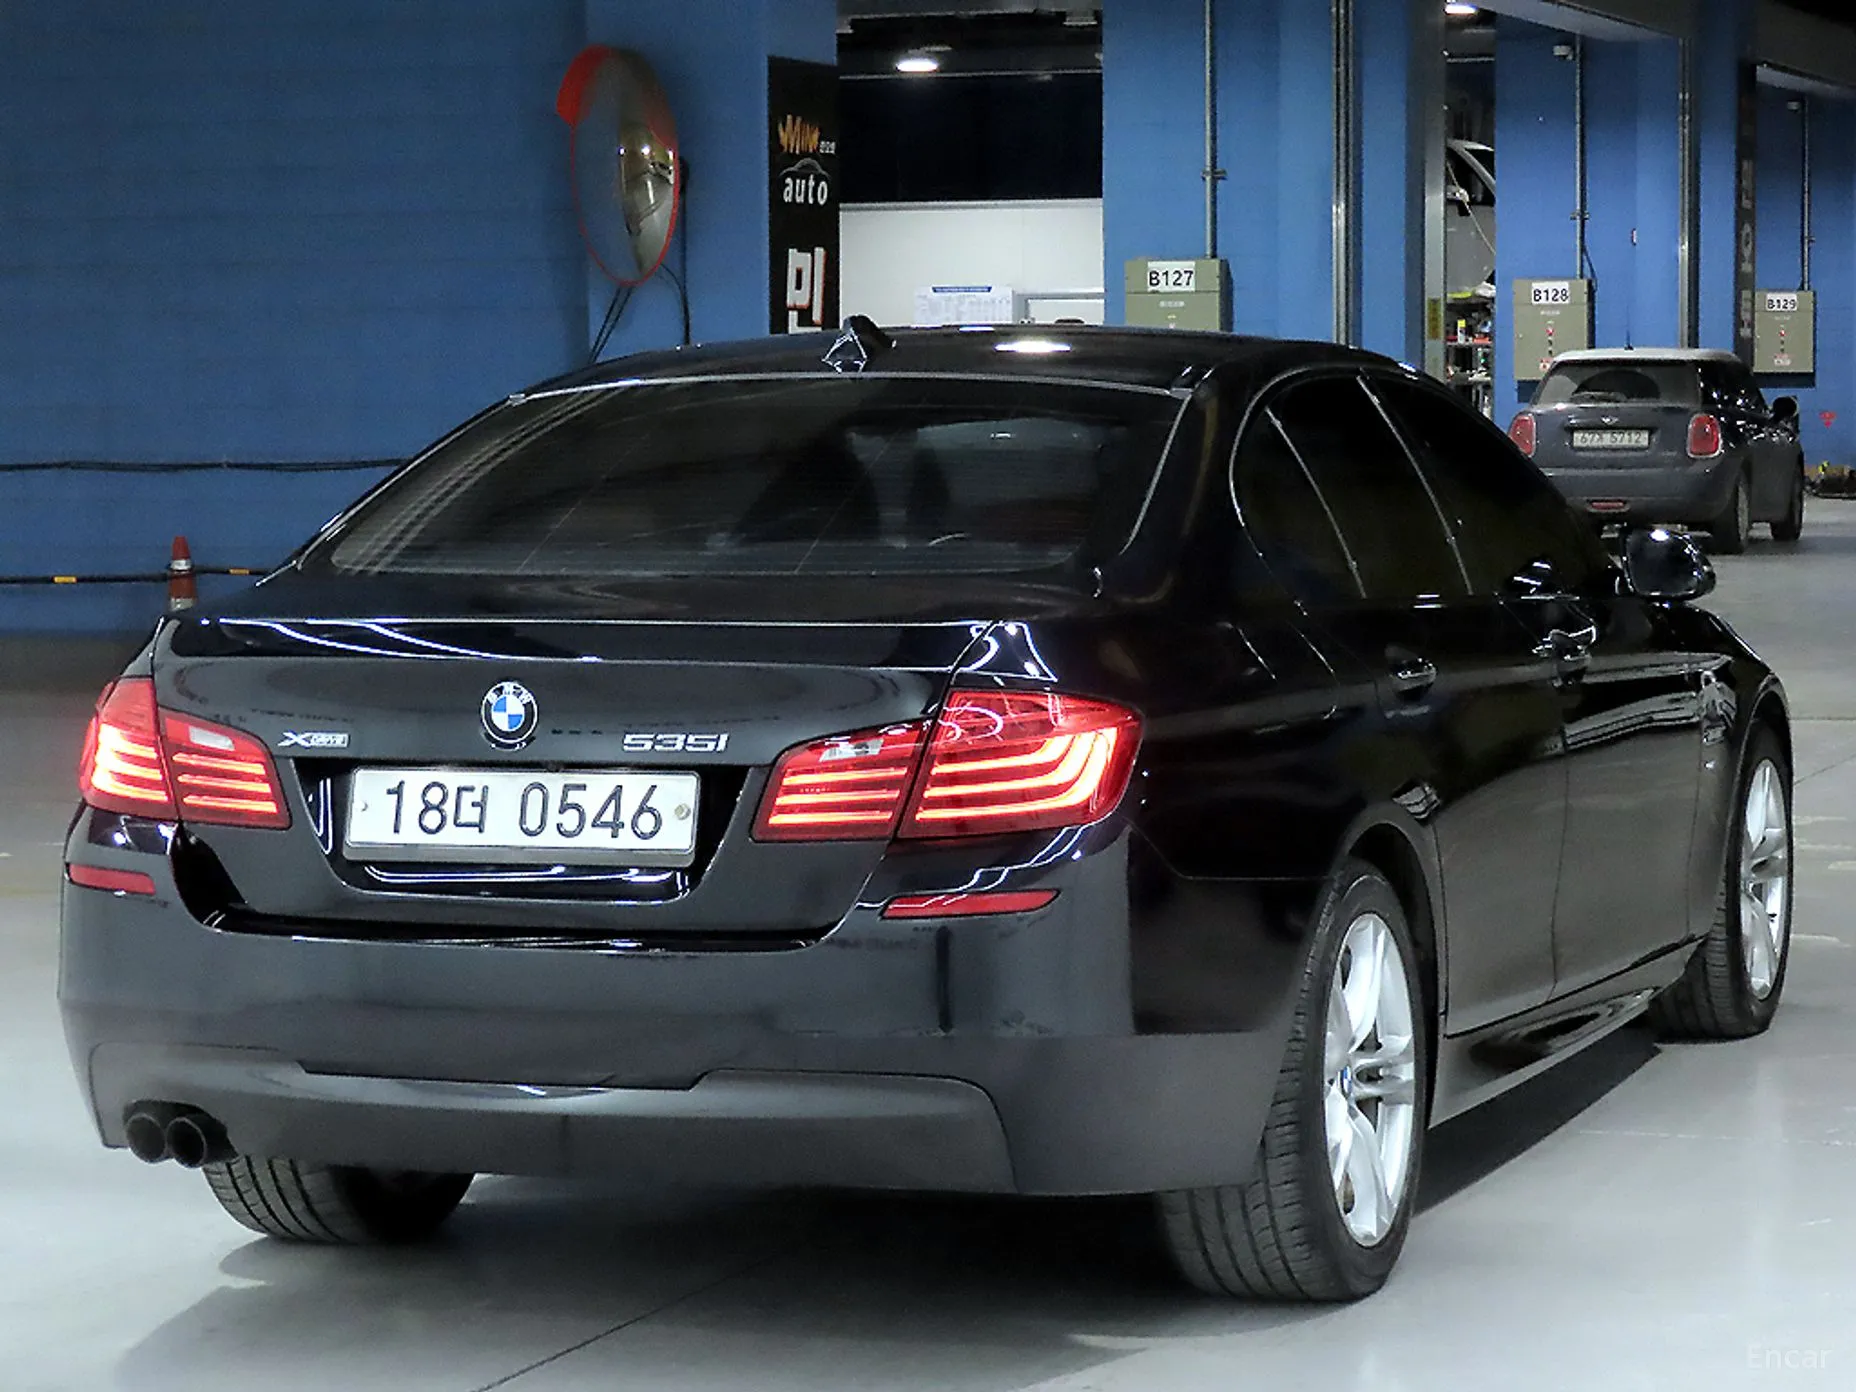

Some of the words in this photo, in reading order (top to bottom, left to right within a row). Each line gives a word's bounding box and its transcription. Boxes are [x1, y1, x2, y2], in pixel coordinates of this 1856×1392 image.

[783, 174, 828, 206] auto
[1149, 270, 1194, 287] B127
[1533, 288, 1569, 302] B128
[1767, 299, 1796, 310] B129
[386, 780, 489, 834] 18더
[519, 781, 663, 840] 0546
